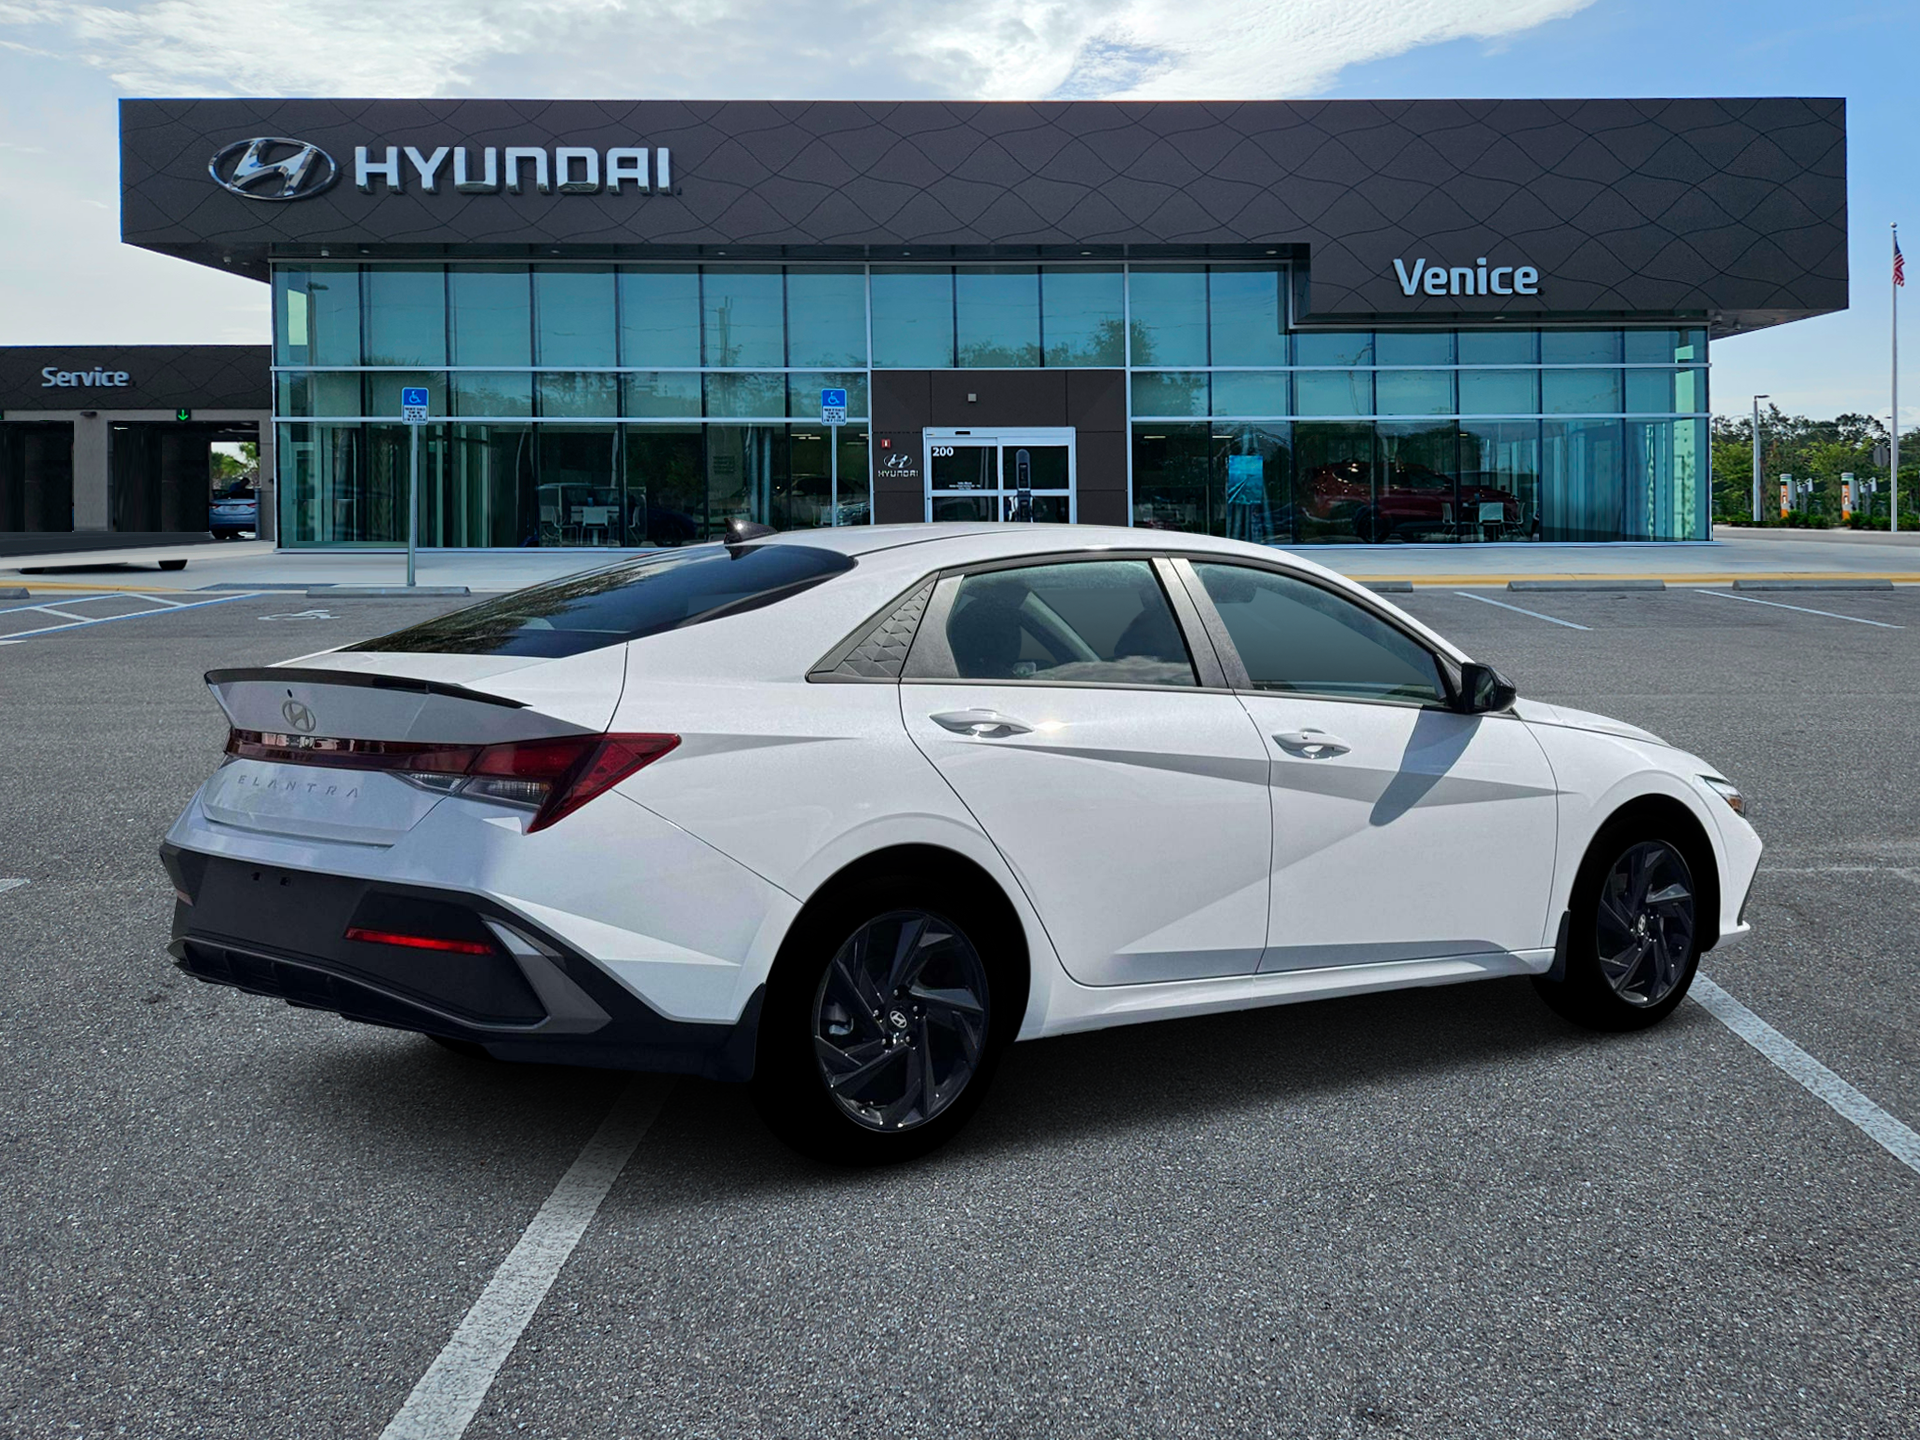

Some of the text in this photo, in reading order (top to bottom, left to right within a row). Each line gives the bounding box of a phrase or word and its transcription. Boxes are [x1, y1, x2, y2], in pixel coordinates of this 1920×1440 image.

[354, 145, 670, 194] HYUNDAI
[1393, 257, 1539, 296] Venice
[41, 366, 130, 387] Service
[932, 447, 954, 457] 200
[878, 469, 919, 478] HYUNDAI
[236, 774, 359, 798] ELANTRA
